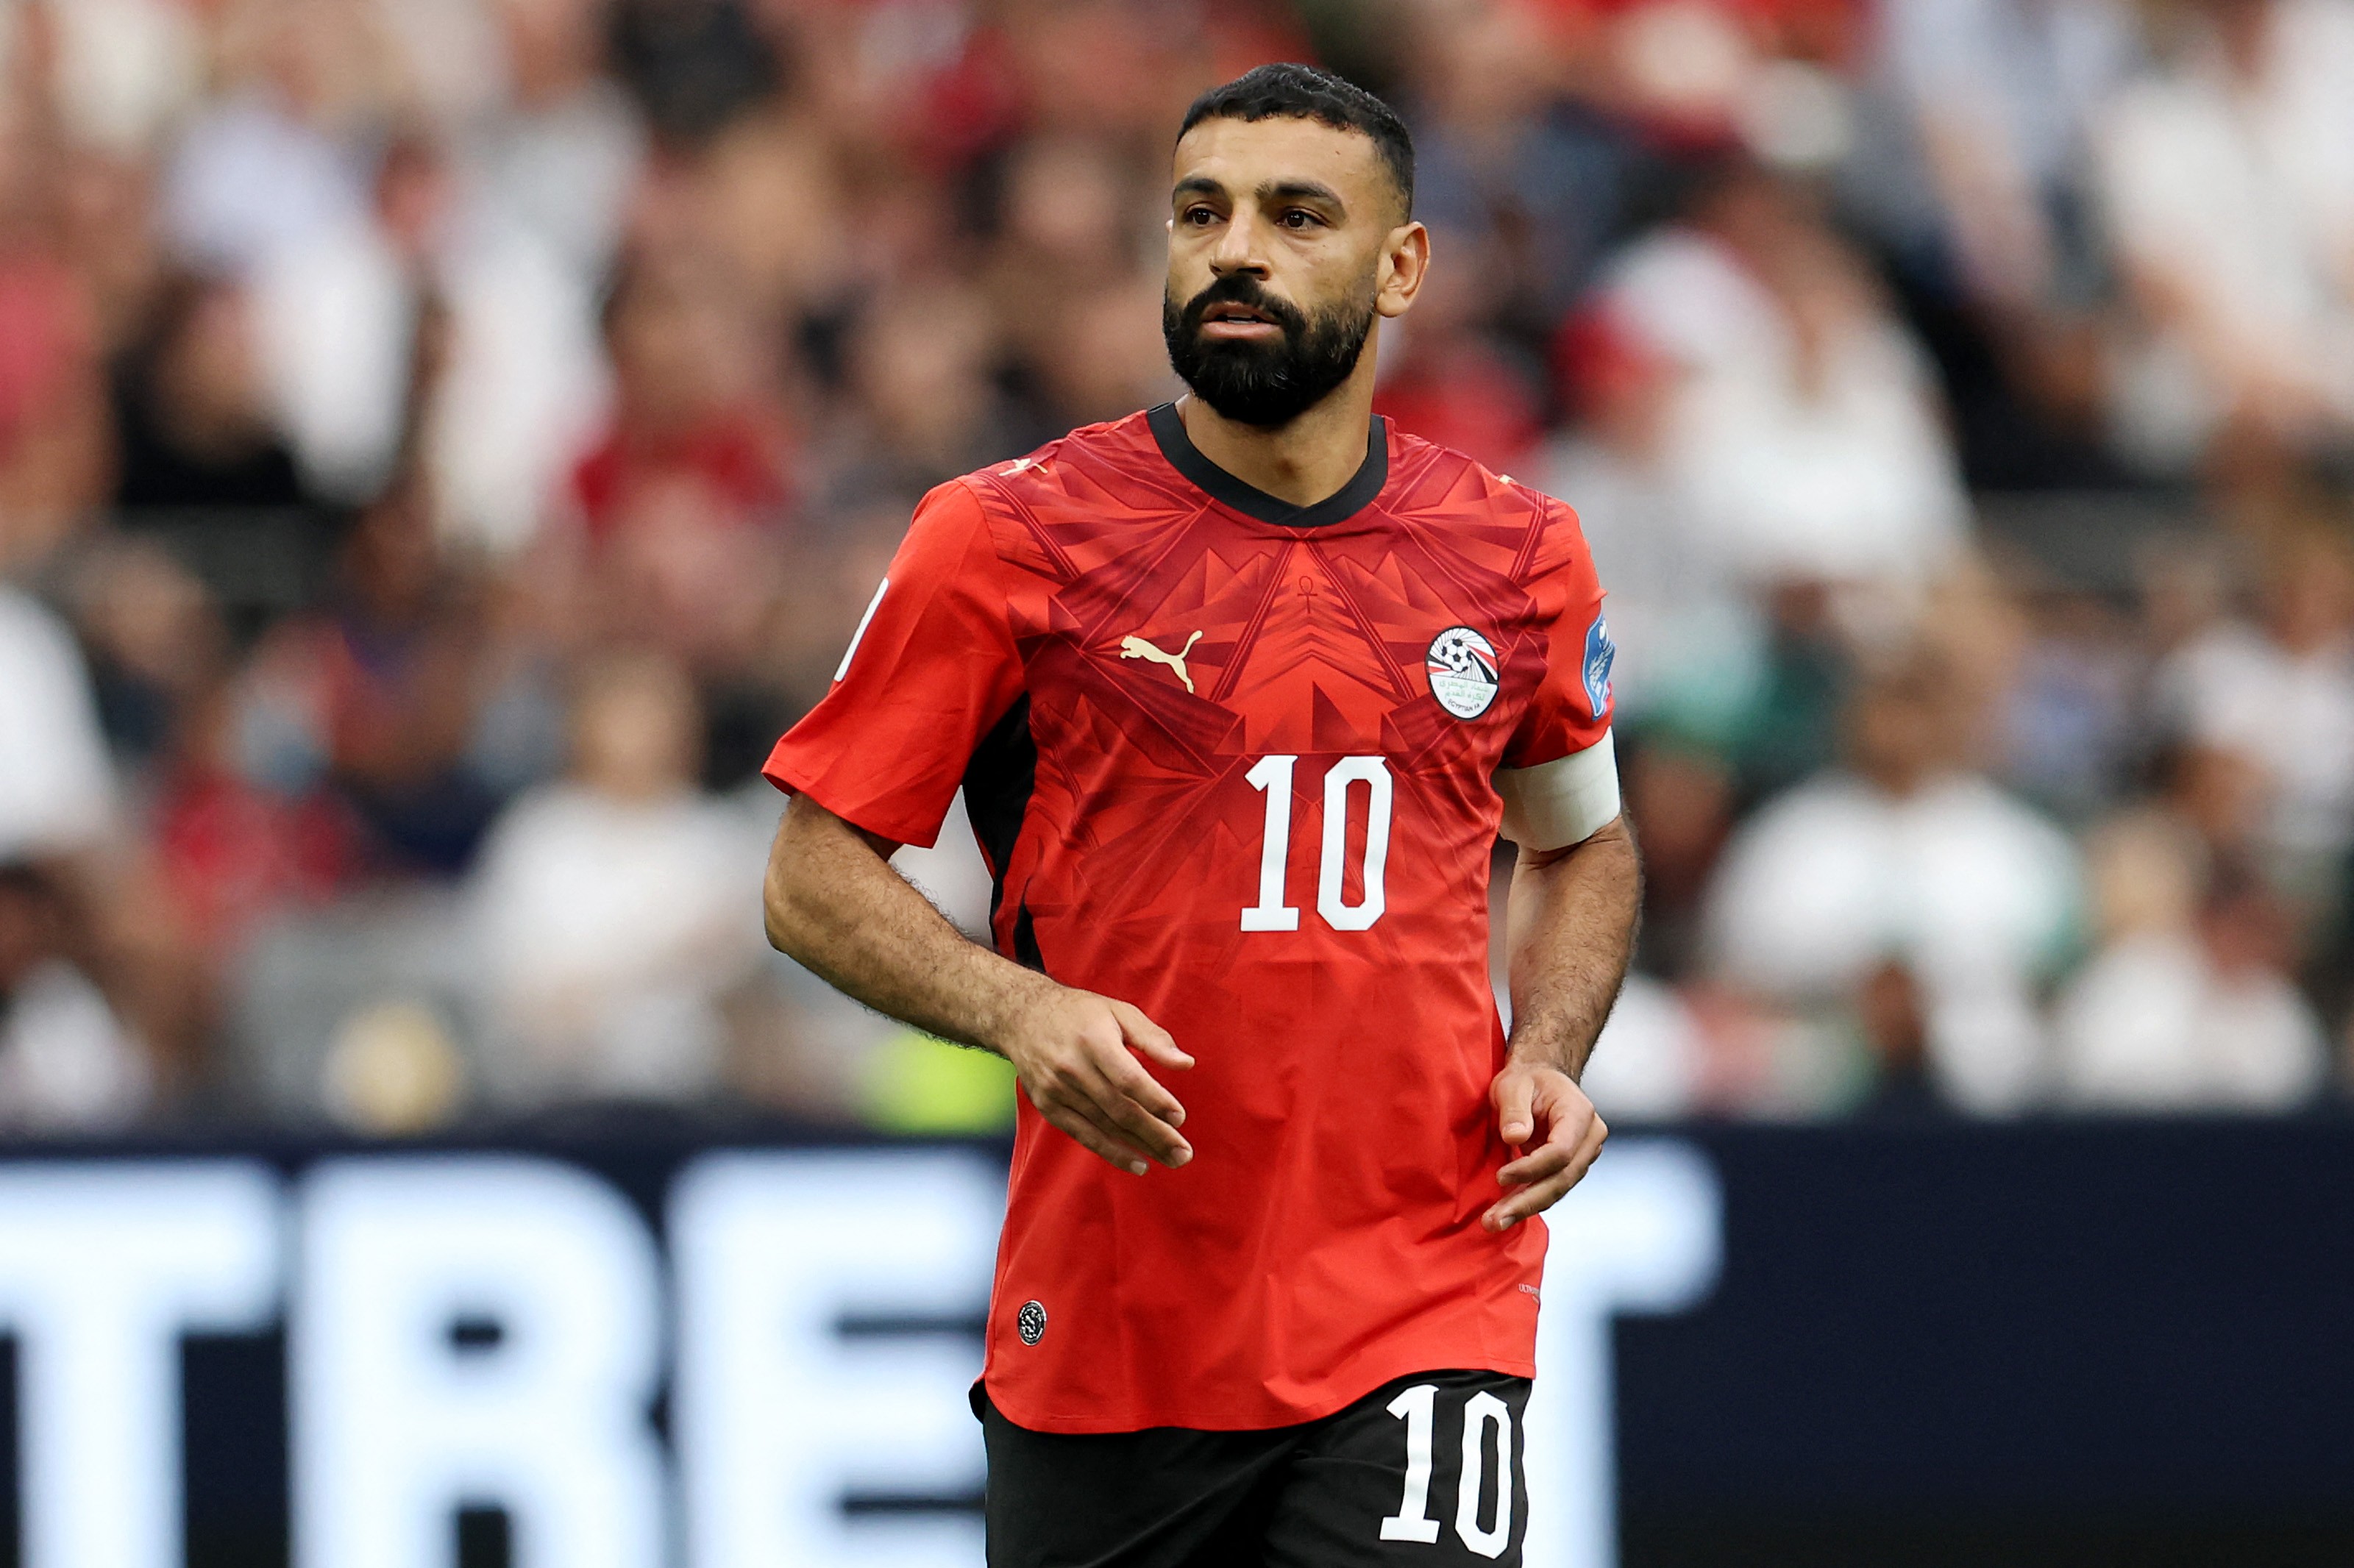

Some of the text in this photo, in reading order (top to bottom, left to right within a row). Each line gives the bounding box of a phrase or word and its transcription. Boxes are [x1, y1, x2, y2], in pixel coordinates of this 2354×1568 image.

[1448, 699, 1473, 711] EGYPTIAN
[1240, 755, 1393, 932] 10
[1379, 1384, 1512, 1560] 10
